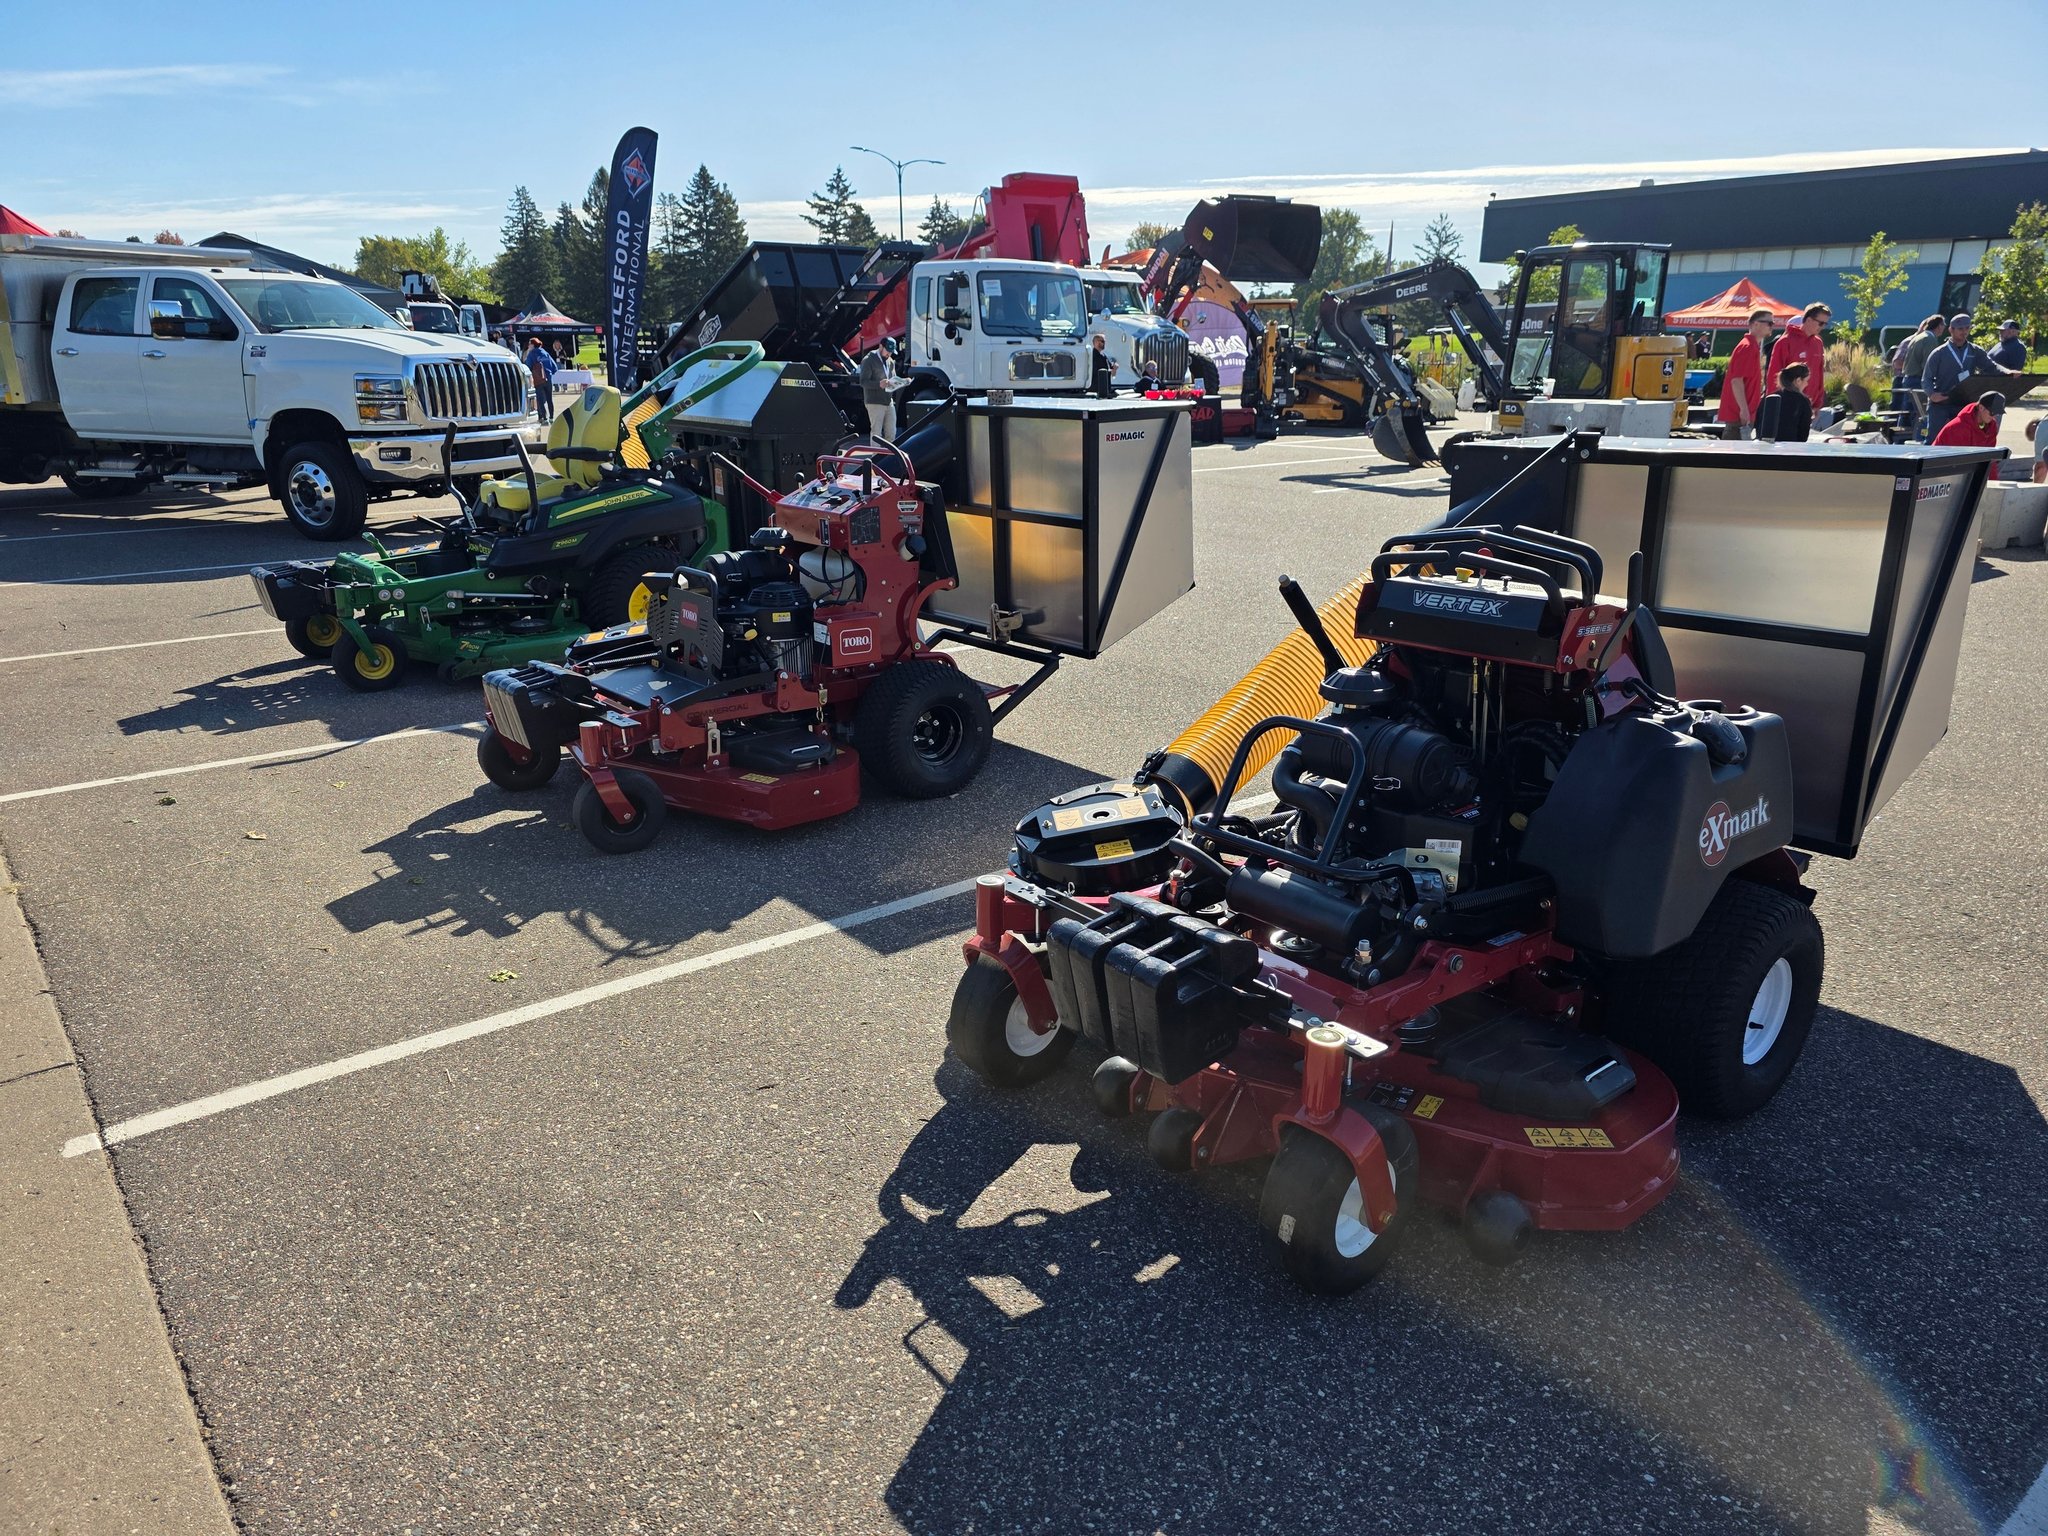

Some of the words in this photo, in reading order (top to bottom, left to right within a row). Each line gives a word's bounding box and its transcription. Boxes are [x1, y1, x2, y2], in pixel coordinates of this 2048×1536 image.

[1141, 248, 1168, 292] HYUNDAI
[619, 219, 644, 368] INTERNATIONAL
[1395, 283, 1428, 299] DEERE
[1505, 319, 1543, 330] SeOne
[781, 379, 816, 387] REDMAGIC
[1505, 405, 1517, 413] 50
[1106, 431, 1145, 442] REDMAGIC
[603, 496, 622, 506] JOHN
[622, 491, 645, 501] DEERE
[1916, 483, 1950, 500] REDMAGIC
[1413, 590, 1508, 617] VERTEX
[682, 608, 697, 622] TORO
[1577, 623, 1613, 638] S-SERIES
[843, 635, 869, 648] TORO
[687, 704, 749, 719] COMMERCIAL
[1699, 797, 1770, 856] eXmark
